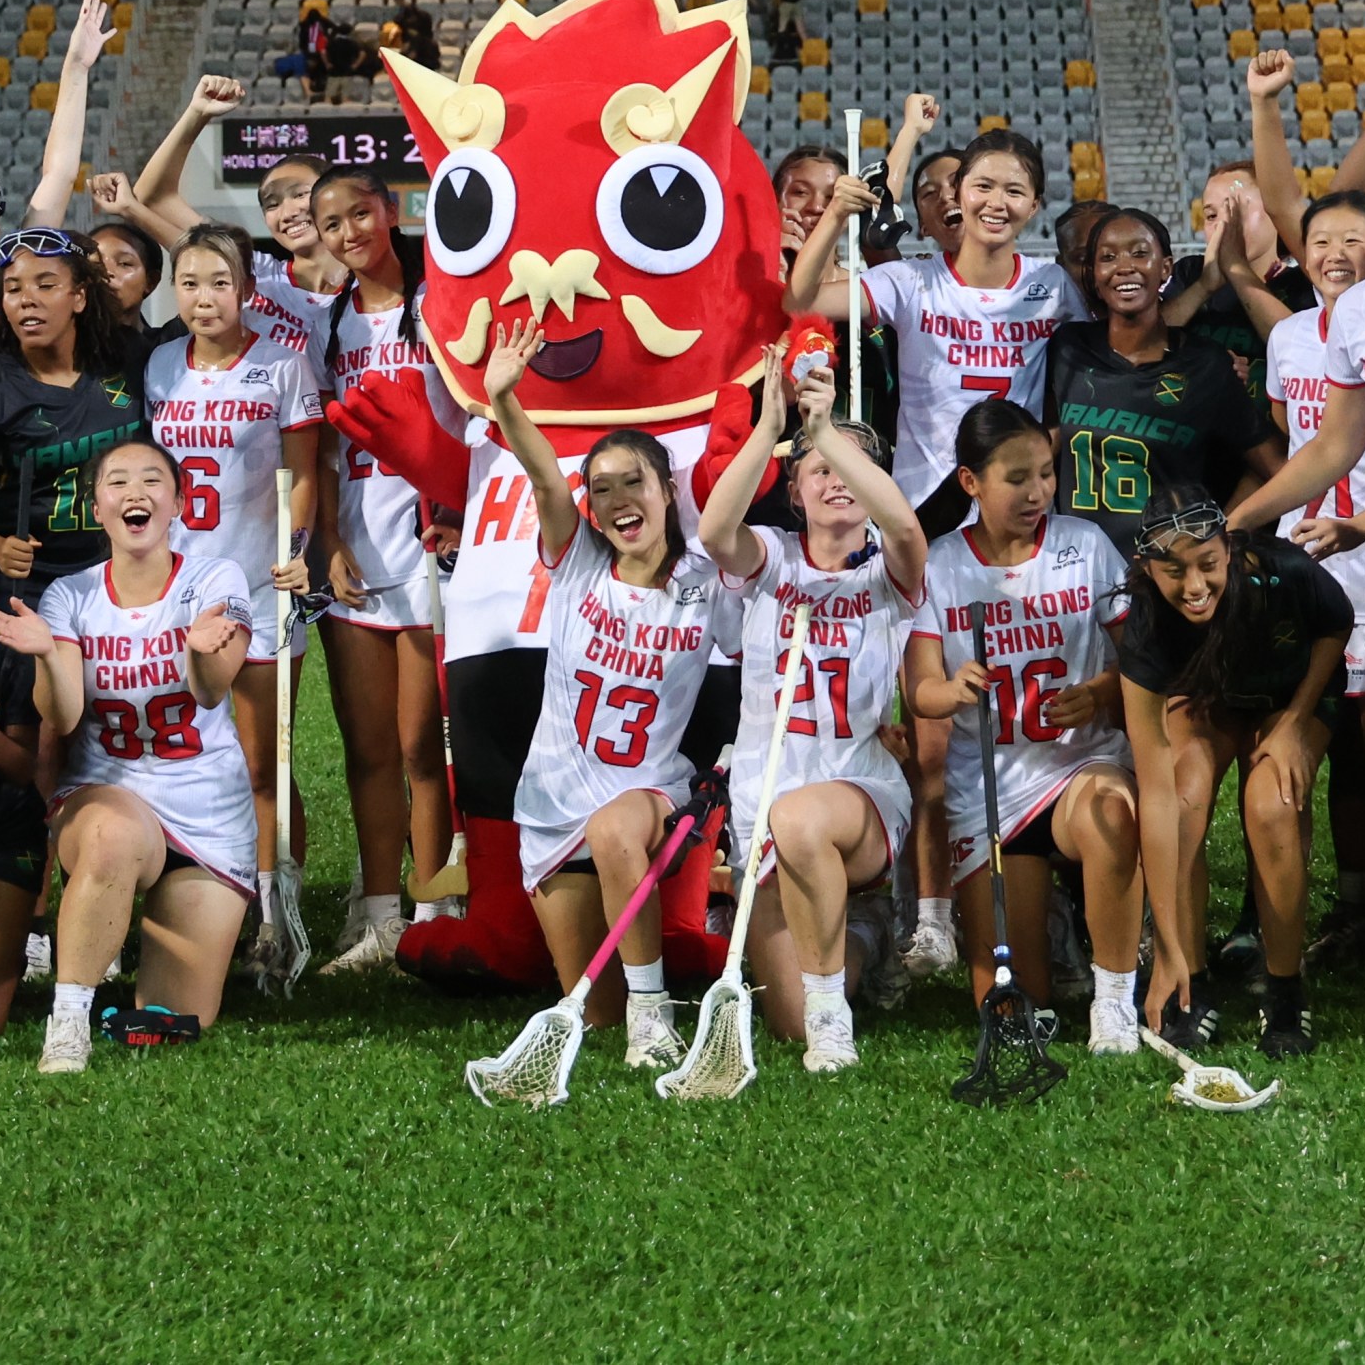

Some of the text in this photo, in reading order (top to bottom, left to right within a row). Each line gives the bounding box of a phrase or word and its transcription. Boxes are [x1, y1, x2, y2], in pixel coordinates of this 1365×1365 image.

[222, 154, 256, 169] HONG
[257, 153, 287, 169] KON
[269, 323, 310, 353] CHI
[919, 308, 1058, 343] HONG KONG
[335, 346, 372, 378] ONG
[947, 343, 1026, 368] CHINA
[204, 399, 274, 422] KONG
[1059, 401, 1197, 446] JAMAICA
[160, 425, 235, 449] CHINA
[1069, 430, 1152, 514] 18
[179, 455, 221, 532] 6
[578, 590, 703, 652] HONG KONG
[1021, 585, 1091, 621] KONG
[80, 625, 192, 661] ONG KON
[779, 613, 848, 648] CNA
[96, 659, 181, 691] CHINA
[585, 636, 664, 681] CHINA
[774, 648, 853, 739] 21
[988, 656, 1068, 745] 16
[574, 668, 660, 769] 13
